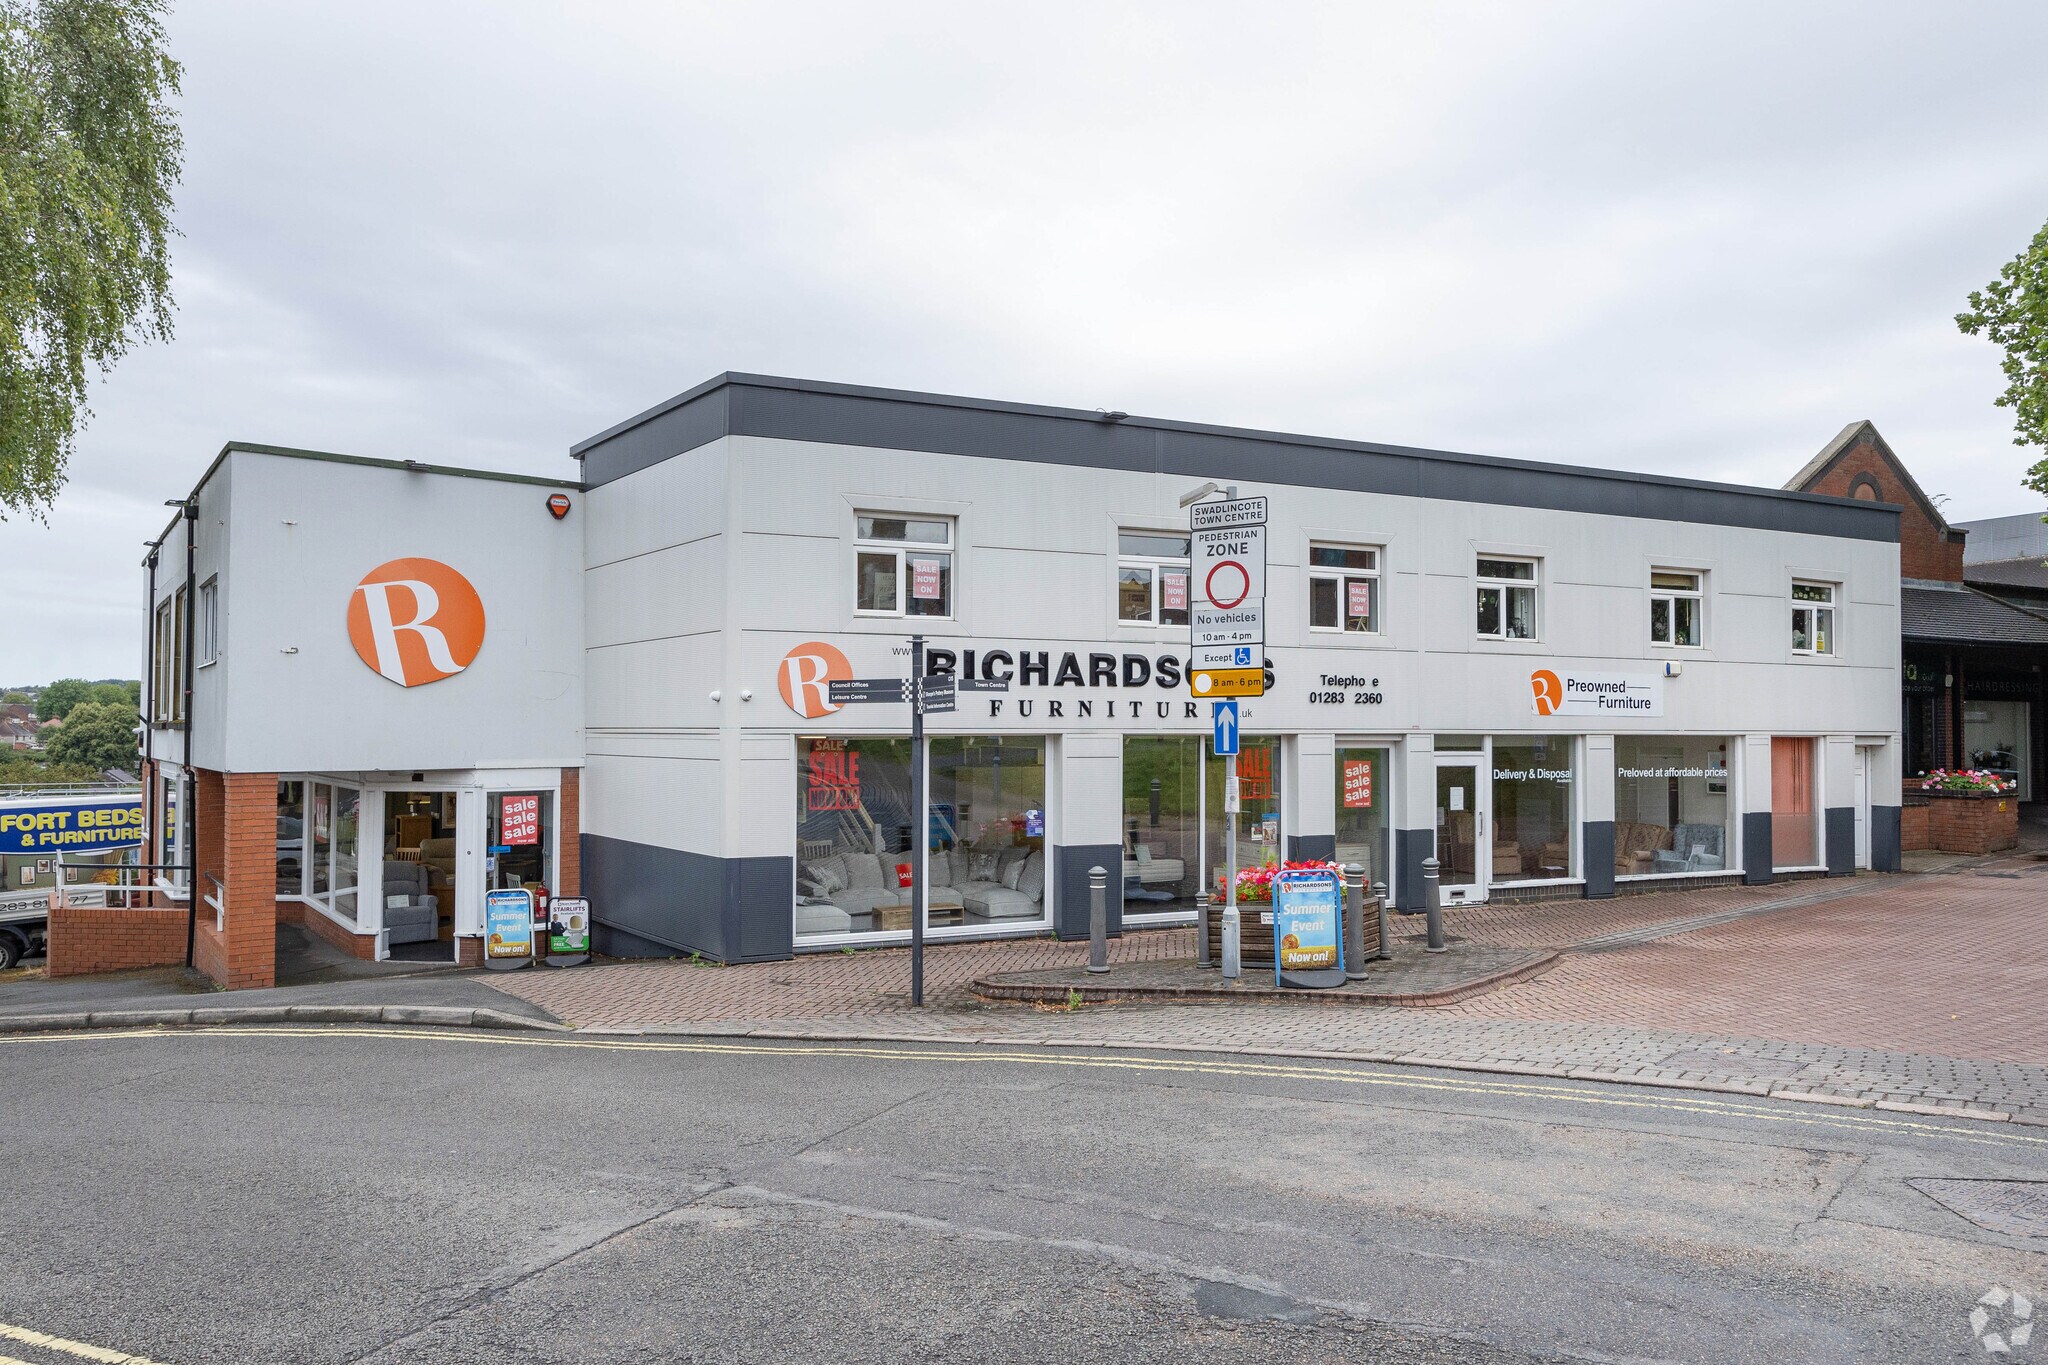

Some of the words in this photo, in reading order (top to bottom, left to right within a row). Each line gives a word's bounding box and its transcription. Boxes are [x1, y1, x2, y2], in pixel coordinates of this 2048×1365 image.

[1194, 501, 1263, 516] SWADLINCOTE
[1194, 515, 1222, 525] TOWN
[1224, 510, 1263, 523] CENTRE
[1198, 530, 1258, 542] PEDESTRIAN
[1206, 542, 1249, 557] ZONE
[917, 575, 936, 583] NOW
[1351, 587, 1367, 595] SALE
[1197, 615, 1212, 625] No
[1214, 612, 1257, 624] vehicles
[356, 579, 467, 687] R
[1202, 633, 1212, 641] 10
[1231, 632, 1238, 640] 4
[1239, 633, 1252, 641] pm
[892, 647, 913, 656] ww
[1204, 653, 1233, 663] Except
[1213, 678, 1219, 687] 8
[1239, 678, 1246, 686] 6
[1247, 678, 1261, 687] pm
[1567, 678, 1626, 693] Preowned
[1967, 680, 2040, 693] HAIRDRESSING
[1309, 691, 1345, 704] 01283
[1354, 692, 1383, 704] 2360
[1598, 695, 1651, 709] Furniture
[989, 699, 1215, 718] FURNITUR
[815, 740, 844, 751] SALE
[808, 751, 860, 787] SALE
[1345, 763, 1370, 778] sale
[1493, 768, 1528, 782] Delivery
[1529, 768, 1536, 779] &
[1537, 767, 1573, 781] Disposal
[1618, 767, 1654, 778] Preloved
[1655, 768, 1663, 777] at
[1664, 767, 1703, 777] affordable
[1704, 768, 1728, 779] prices
[1345, 775, 1370, 790] sale
[1345, 787, 1370, 802] sale
[504, 798, 537, 814] sale
[77, 807, 143, 828] BEDS
[504, 811, 536, 827] sale
[20, 833, 36, 847] &
[39, 827, 143, 846] FURNITURE
[504, 824, 536, 840] sale
[1283, 903, 1332, 915] Summer
[490, 912, 527, 920] Summer
[496, 923, 522, 932] Event
[1291, 919, 1326, 932] Event
[494, 945, 512, 953] Now
[512, 944, 525, 953] on!
[1288, 952, 1311, 963] Now
[1312, 950, 1329, 961] on!
